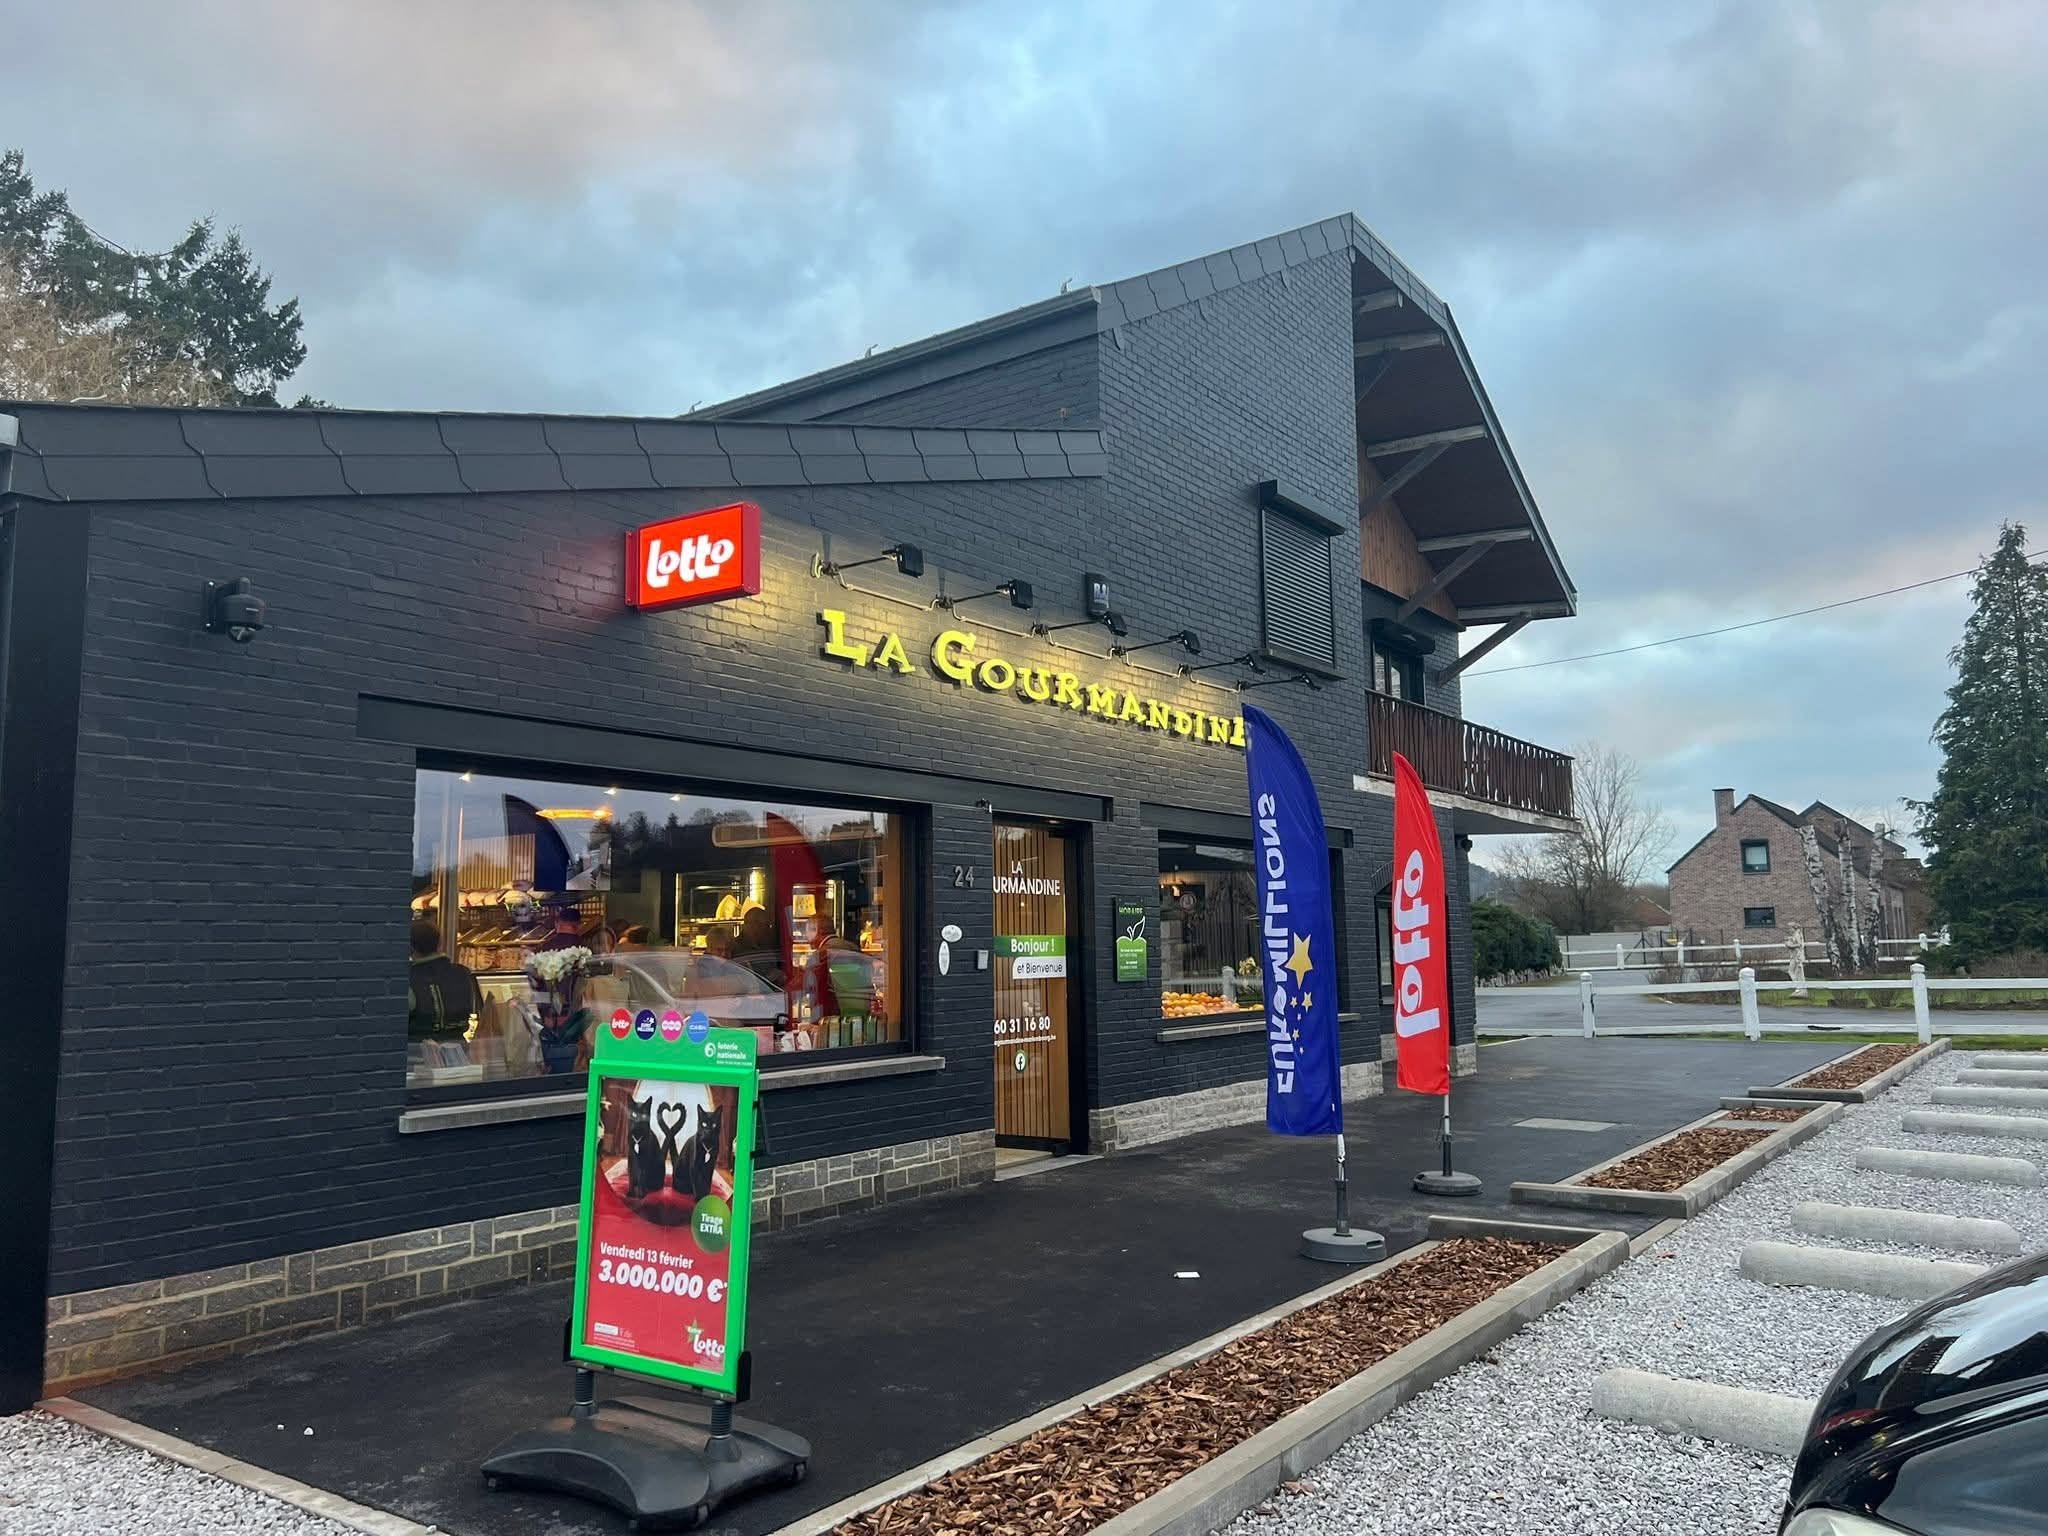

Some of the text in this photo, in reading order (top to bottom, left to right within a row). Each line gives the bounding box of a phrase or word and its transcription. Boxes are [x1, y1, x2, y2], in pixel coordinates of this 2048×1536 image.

[1011, 861, 1023, 874] LA
[955, 865, 975, 888] 24
[1011, 938, 1049, 955] Bonjour
[1017, 962, 1063, 974] et Bienvenue
[994, 1016, 1051, 1034] 60 31 16 80
[700, 1212, 723, 1225] Tirage
[699, 1222, 723, 1236] EXTRA
[600, 1242, 694, 1269] Vendredi 13 février
[598, 1259, 703, 1299] 3.000.000
